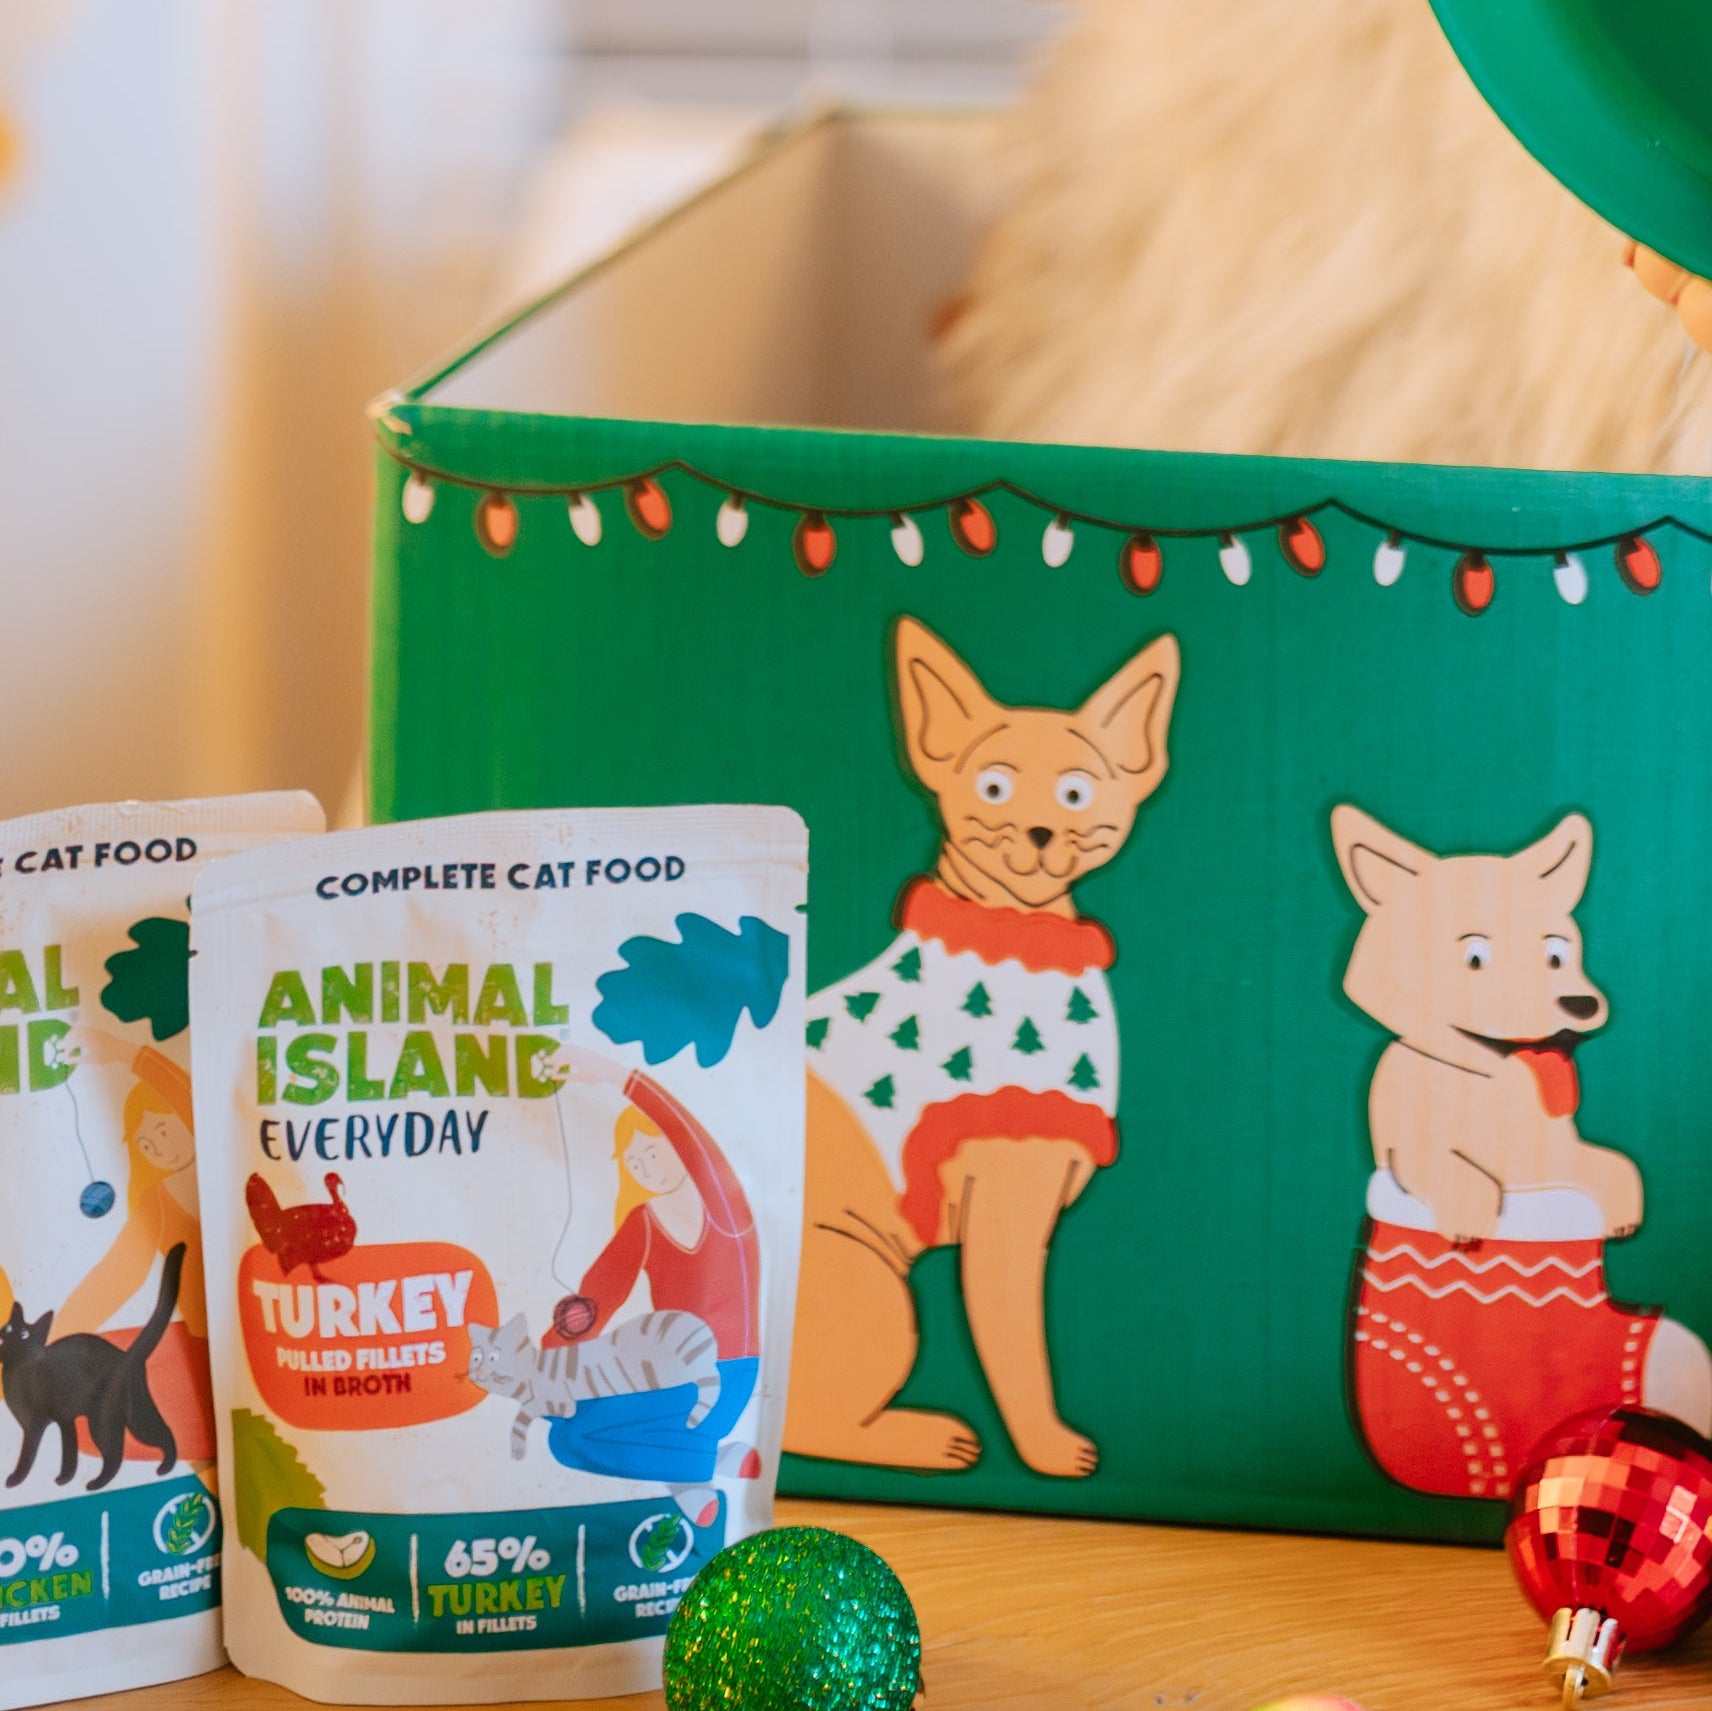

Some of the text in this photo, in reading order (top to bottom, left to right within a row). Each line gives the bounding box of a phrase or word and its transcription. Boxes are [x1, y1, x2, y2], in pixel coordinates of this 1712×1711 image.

[15, 845, 83, 874] CAT
[94, 837, 197, 868] FOOD
[316, 855, 686, 900] COMPLETE CAT FOOD
[257, 960, 569, 1028] ANIMAL
[257, 1030, 569, 1106] ISLAND
[260, 1109, 490, 1161] EVERYDAY
[252, 1270, 473, 1338] TURKEY
[276, 1341, 446, 1372] PULLED FILLETS
[304, 1373, 411, 1396] IN BROTH
[0, 1532, 79, 1578] 0%
[444, 1535, 550, 1578] 65%
[0, 1569, 92, 1609] CKEN
[159, 1574, 211, 1600] RECIPE
[285, 1587, 396, 1613] 100% ANIMAL
[427, 1574, 566, 1617] TURKEY
[0, 1605, 60, 1627] FILLETS
[305, 1608, 370, 1630] PROTEIN
[456, 1615, 537, 1634] IN FILLETS
